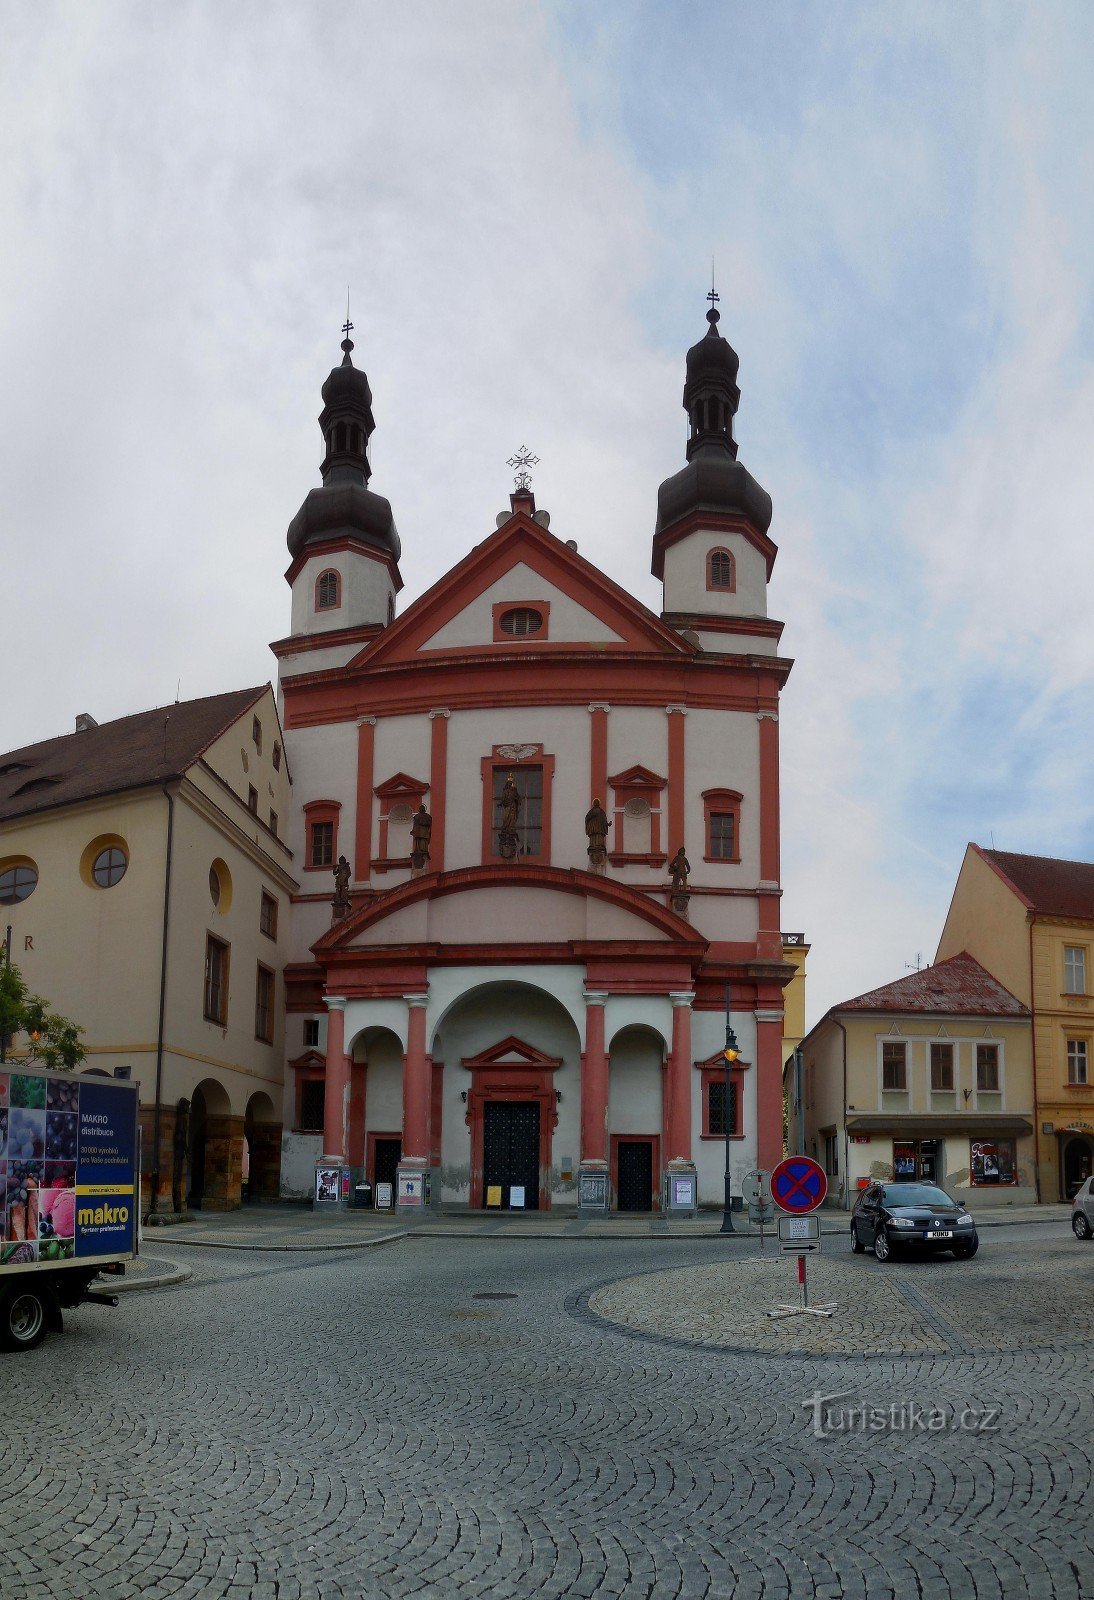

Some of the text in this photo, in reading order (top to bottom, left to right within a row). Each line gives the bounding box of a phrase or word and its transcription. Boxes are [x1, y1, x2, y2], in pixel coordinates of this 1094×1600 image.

[81, 1114, 108, 1124] MAKRO
[81, 1127, 114, 1136] distribuce
[90, 1156, 104, 1164] Vaše
[78, 1203, 129, 1225] makro
